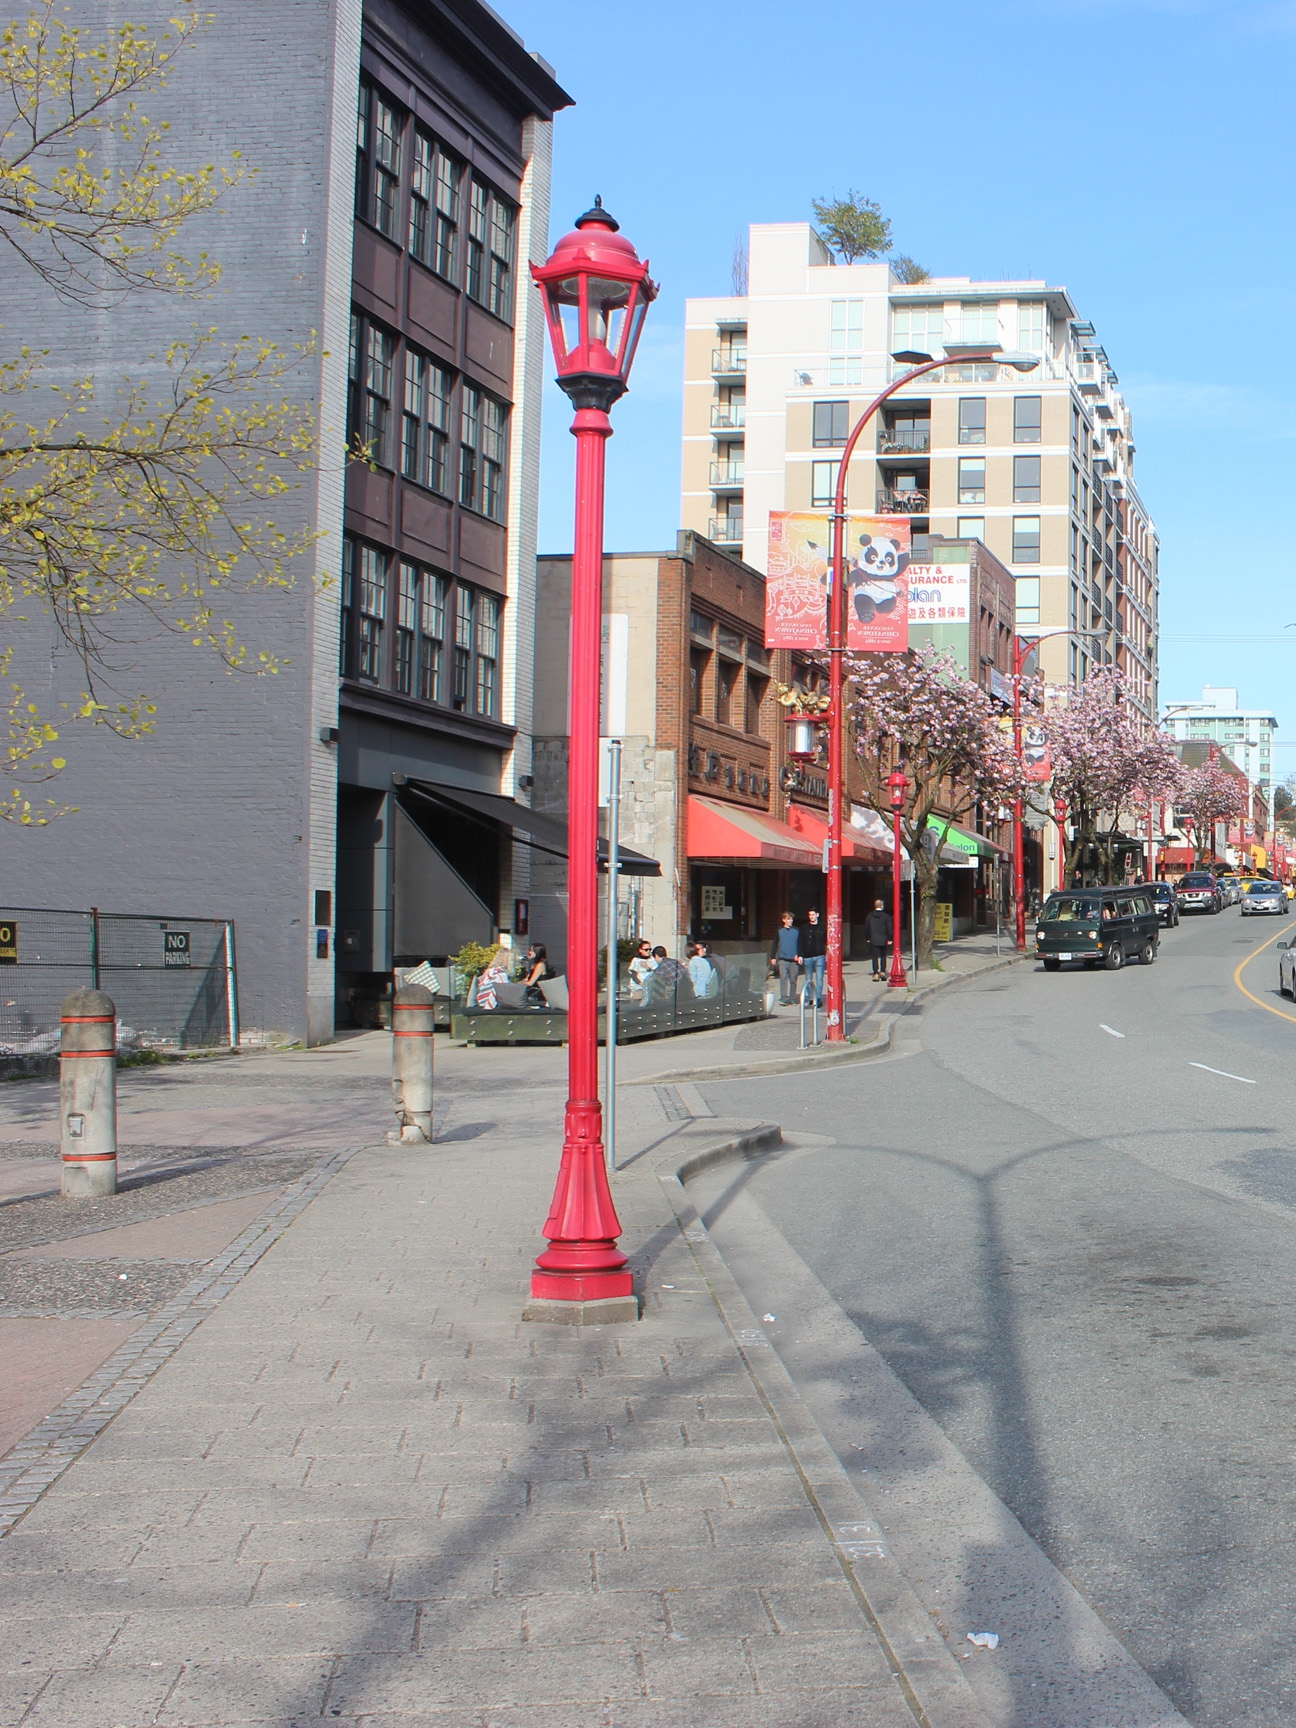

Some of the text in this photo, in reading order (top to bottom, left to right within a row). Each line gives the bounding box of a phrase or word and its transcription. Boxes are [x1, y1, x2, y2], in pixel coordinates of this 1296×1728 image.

[935, 566, 942, 575] &
[910, 575, 954, 585] URANCE
[168, 934, 186, 948] NO
[165, 951, 190, 965] PARKING
